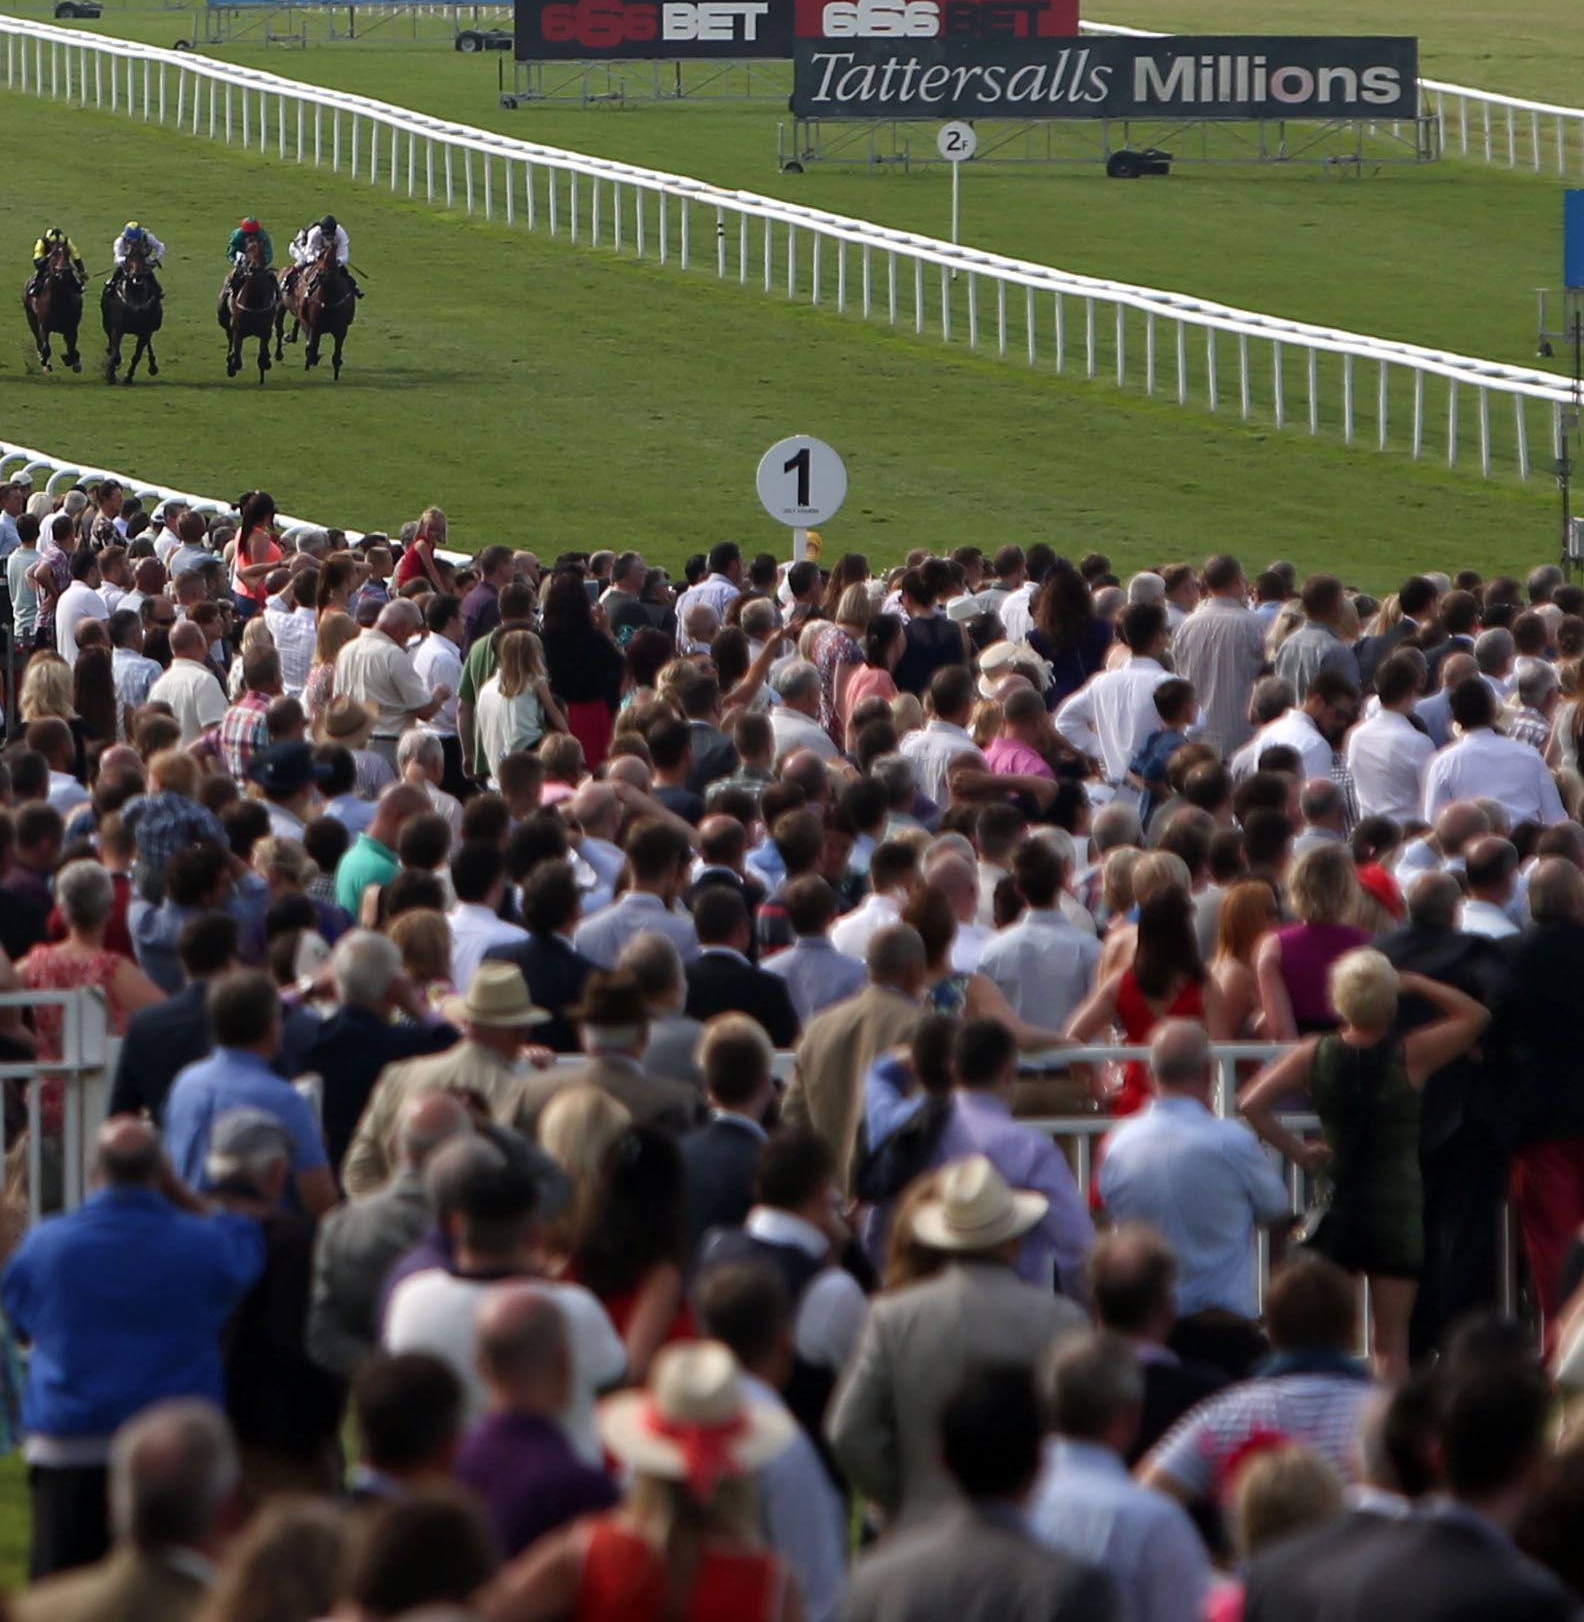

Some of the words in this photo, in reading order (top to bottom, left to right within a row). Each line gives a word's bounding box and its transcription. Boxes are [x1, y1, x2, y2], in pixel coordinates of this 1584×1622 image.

[809, 47, 1113, 105] Tattersalls
[1132, 54, 1402, 104] Millions
[947, 131, 969, 150] 2F
[783, 449, 810, 506] 1
